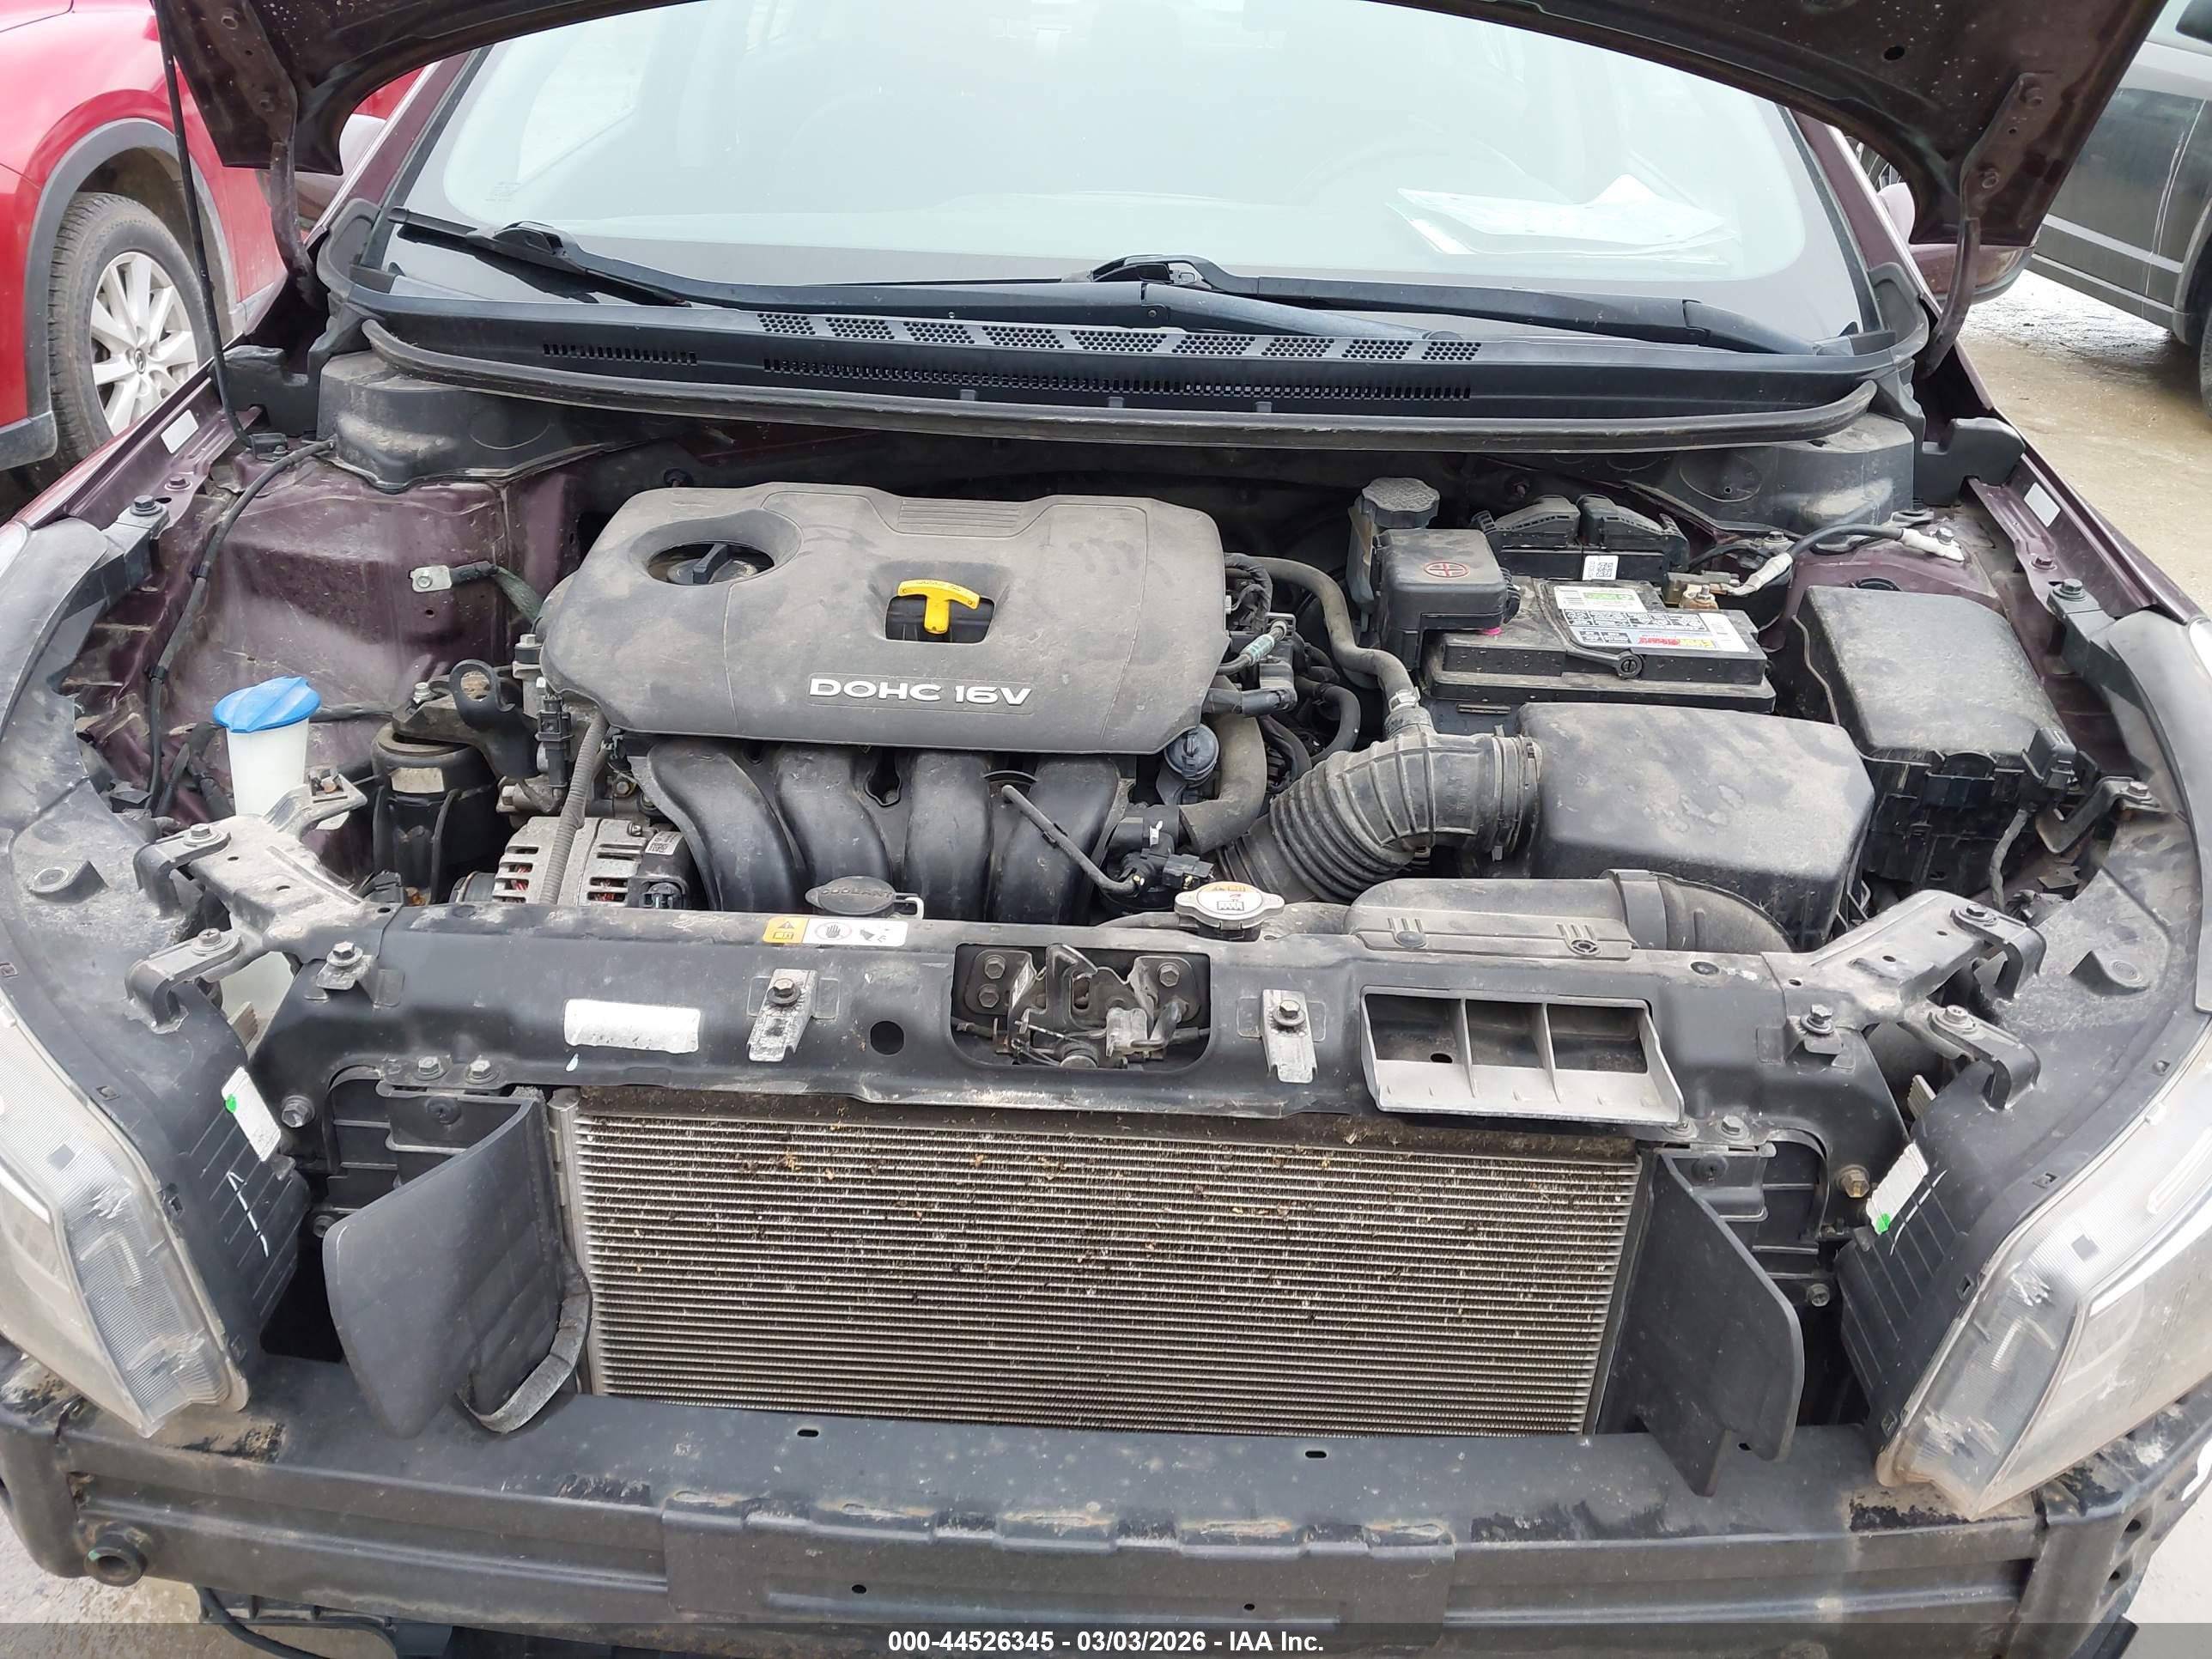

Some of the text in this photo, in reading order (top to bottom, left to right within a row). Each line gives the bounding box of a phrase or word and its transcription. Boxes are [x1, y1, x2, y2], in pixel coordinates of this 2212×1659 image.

[809, 678, 1031, 706] DOHC 16V
[821, 888, 894, 900] COOLANT
